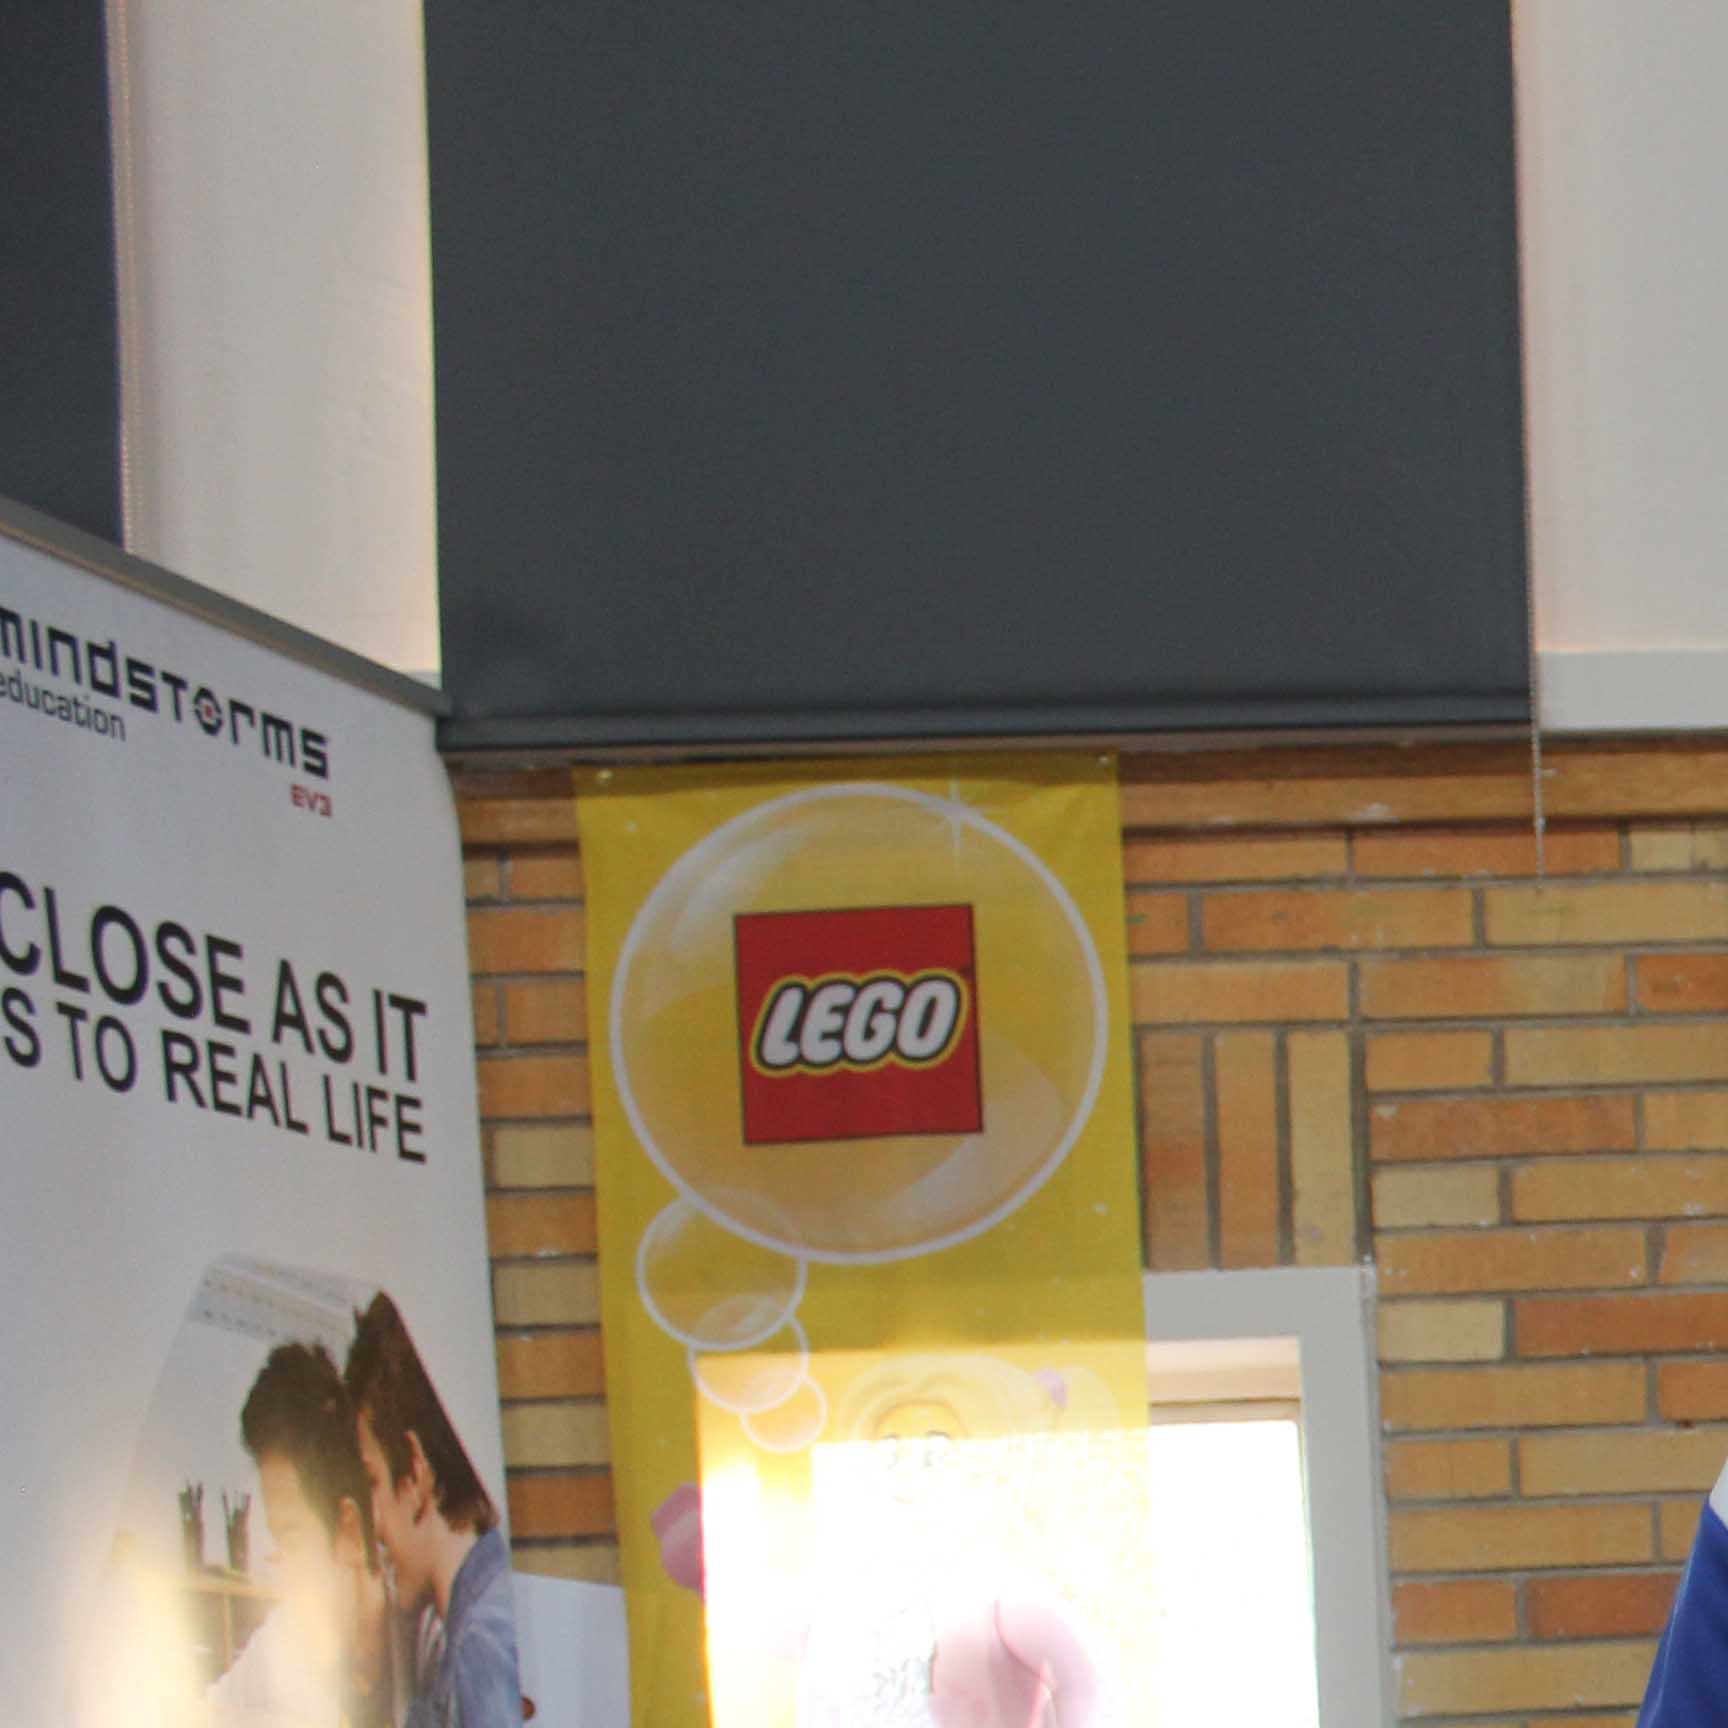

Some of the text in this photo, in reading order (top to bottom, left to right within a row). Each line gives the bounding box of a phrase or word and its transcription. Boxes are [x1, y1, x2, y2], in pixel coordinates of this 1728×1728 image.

[290, 783, 333, 818] EV3
[272, 958, 355, 1064] AS
[373, 988, 427, 1083] IT
[755, 975, 963, 1072] LEGO
[56, 1001, 137, 1093] TO
[160, 1027, 309, 1135] REAL
[321, 1071, 427, 1165] LIFE
